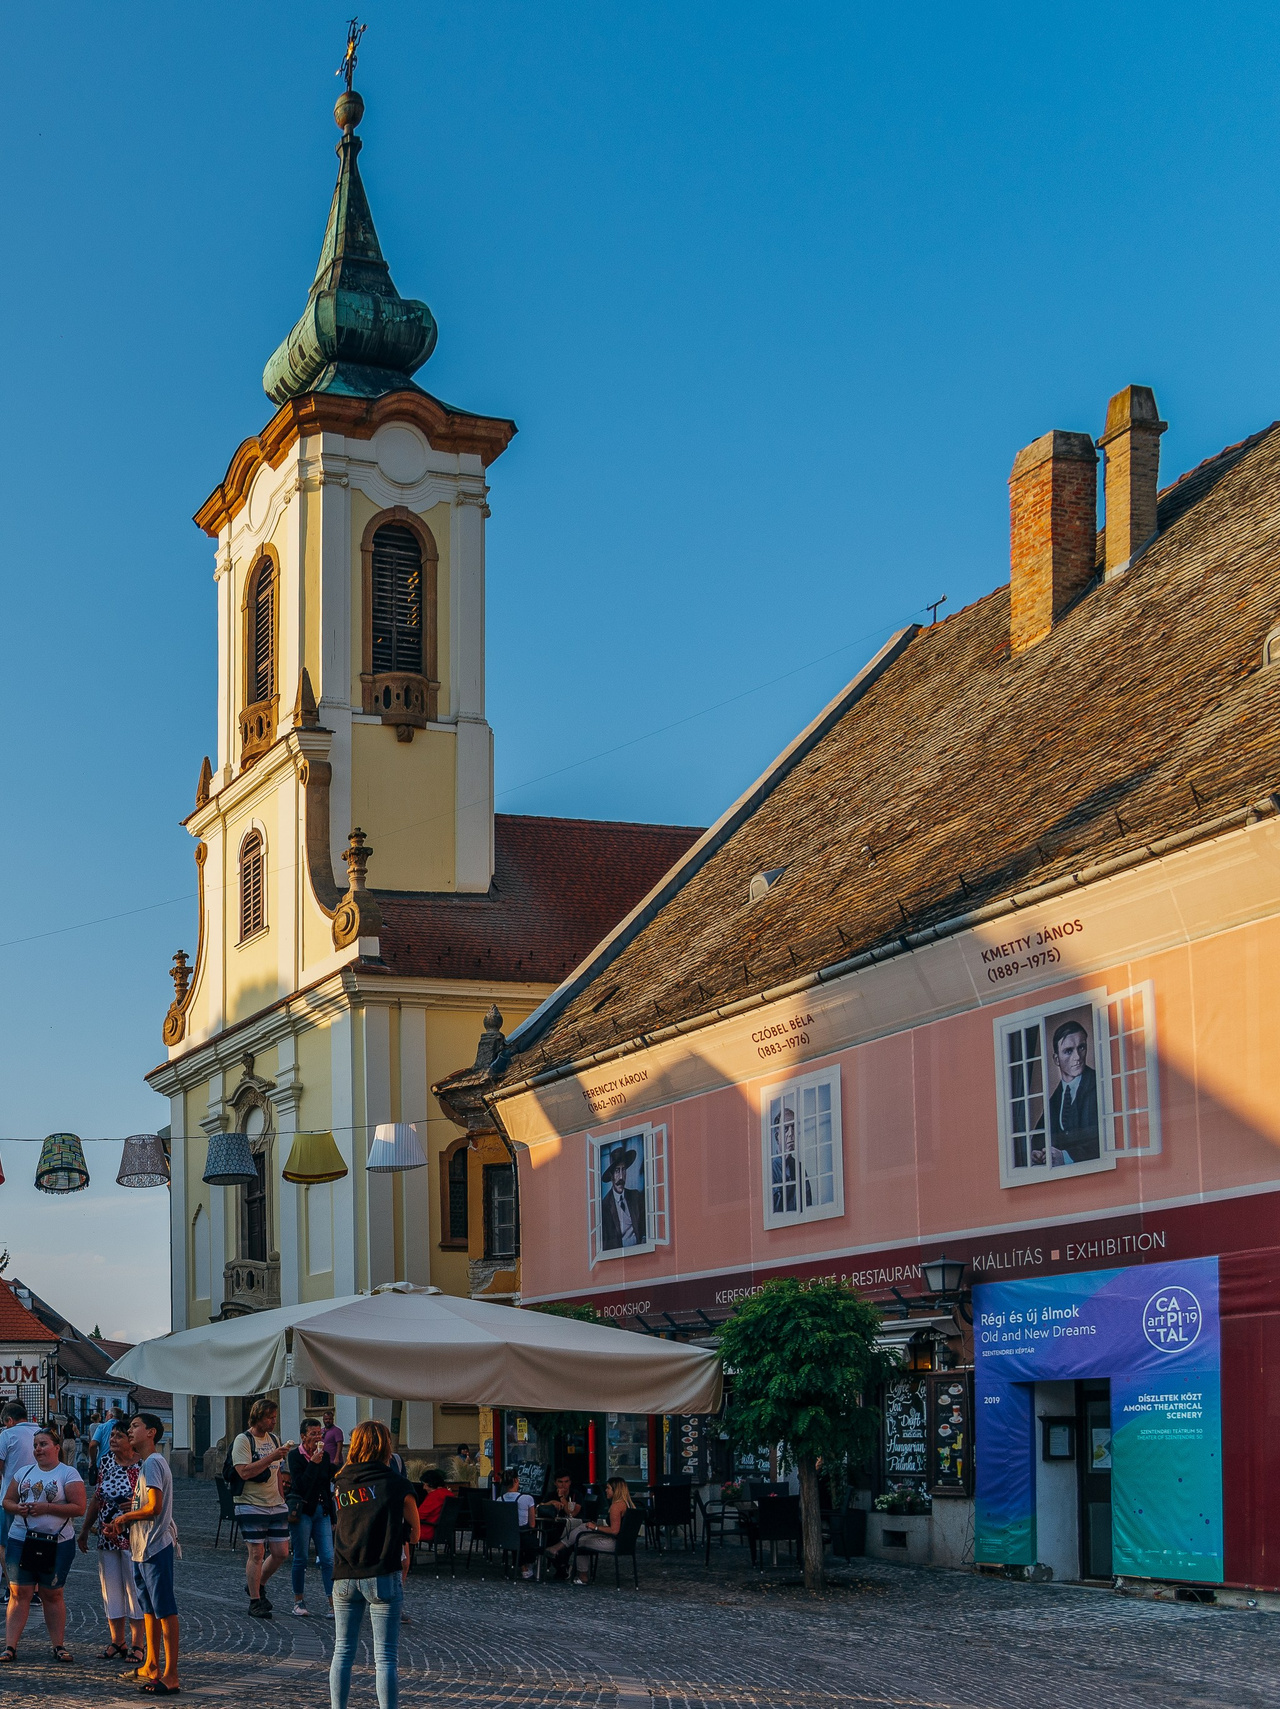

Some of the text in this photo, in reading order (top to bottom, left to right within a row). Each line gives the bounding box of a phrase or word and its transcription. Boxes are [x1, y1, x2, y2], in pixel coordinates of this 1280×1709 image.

[981, 919, 1084, 963] KMETTY JÁNOS
[751, 1013, 815, 1043] CZÓBEL BÉLA
[582, 1069, 649, 1101] FERENCZY KÁROLY
[972, 1230, 1166, 1272] KIÁLLÍTÁS EXHIBITION
[852, 1262, 927, 1287] RESTAURAN
[603, 1300, 651, 1318] BOOKSHOP
[981, 1304, 1080, 1328] Régi és új álmok
[981, 1325, 1097, 1343] Old and New Dreams
[983, 1396, 1000, 1404] 2019
[1123, 1404, 1152, 1412] AMONG
[1138, 1394, 1179, 1402] DÍSZLETEK
[886, 1434, 926, 1456] Hungarian
